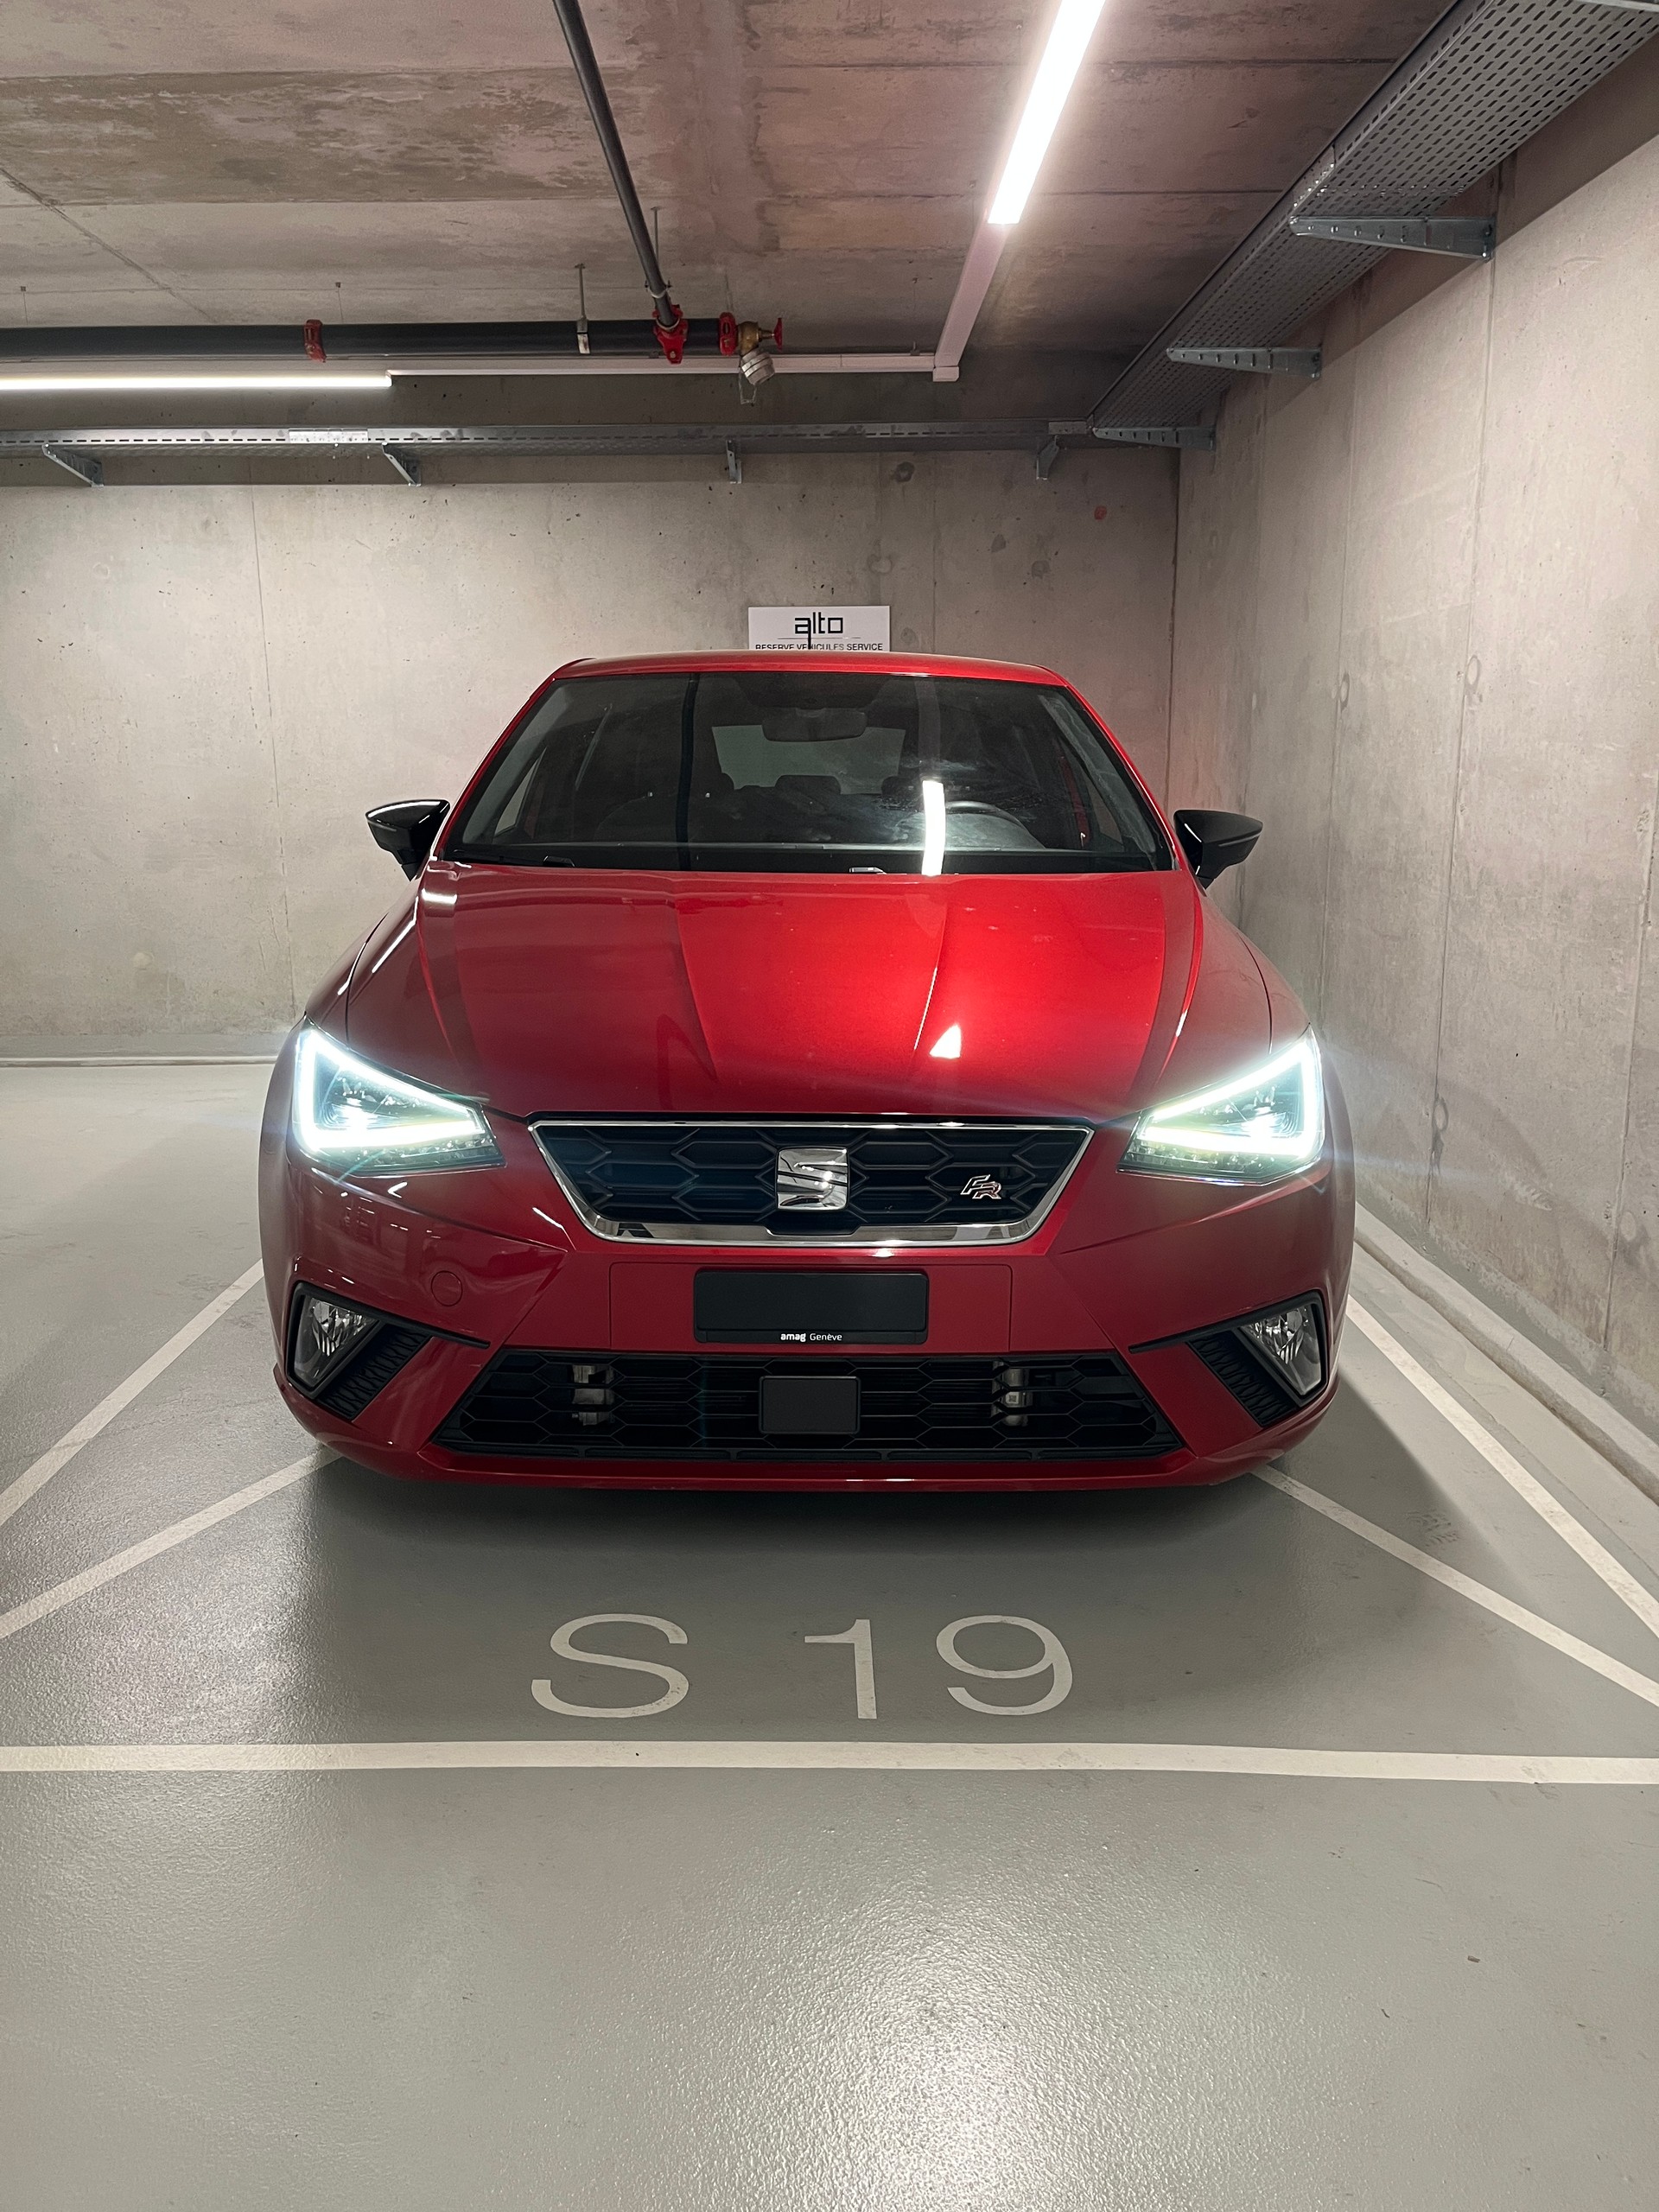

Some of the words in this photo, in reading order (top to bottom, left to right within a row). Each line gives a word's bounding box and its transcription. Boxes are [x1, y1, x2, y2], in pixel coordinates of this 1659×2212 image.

[795, 612, 843, 634] alto
[960, 1174, 1002, 1199] FR
[780, 1332, 806, 1342] amag
[531, 1613, 689, 1718] S
[804, 1615, 1073, 1719] 19
